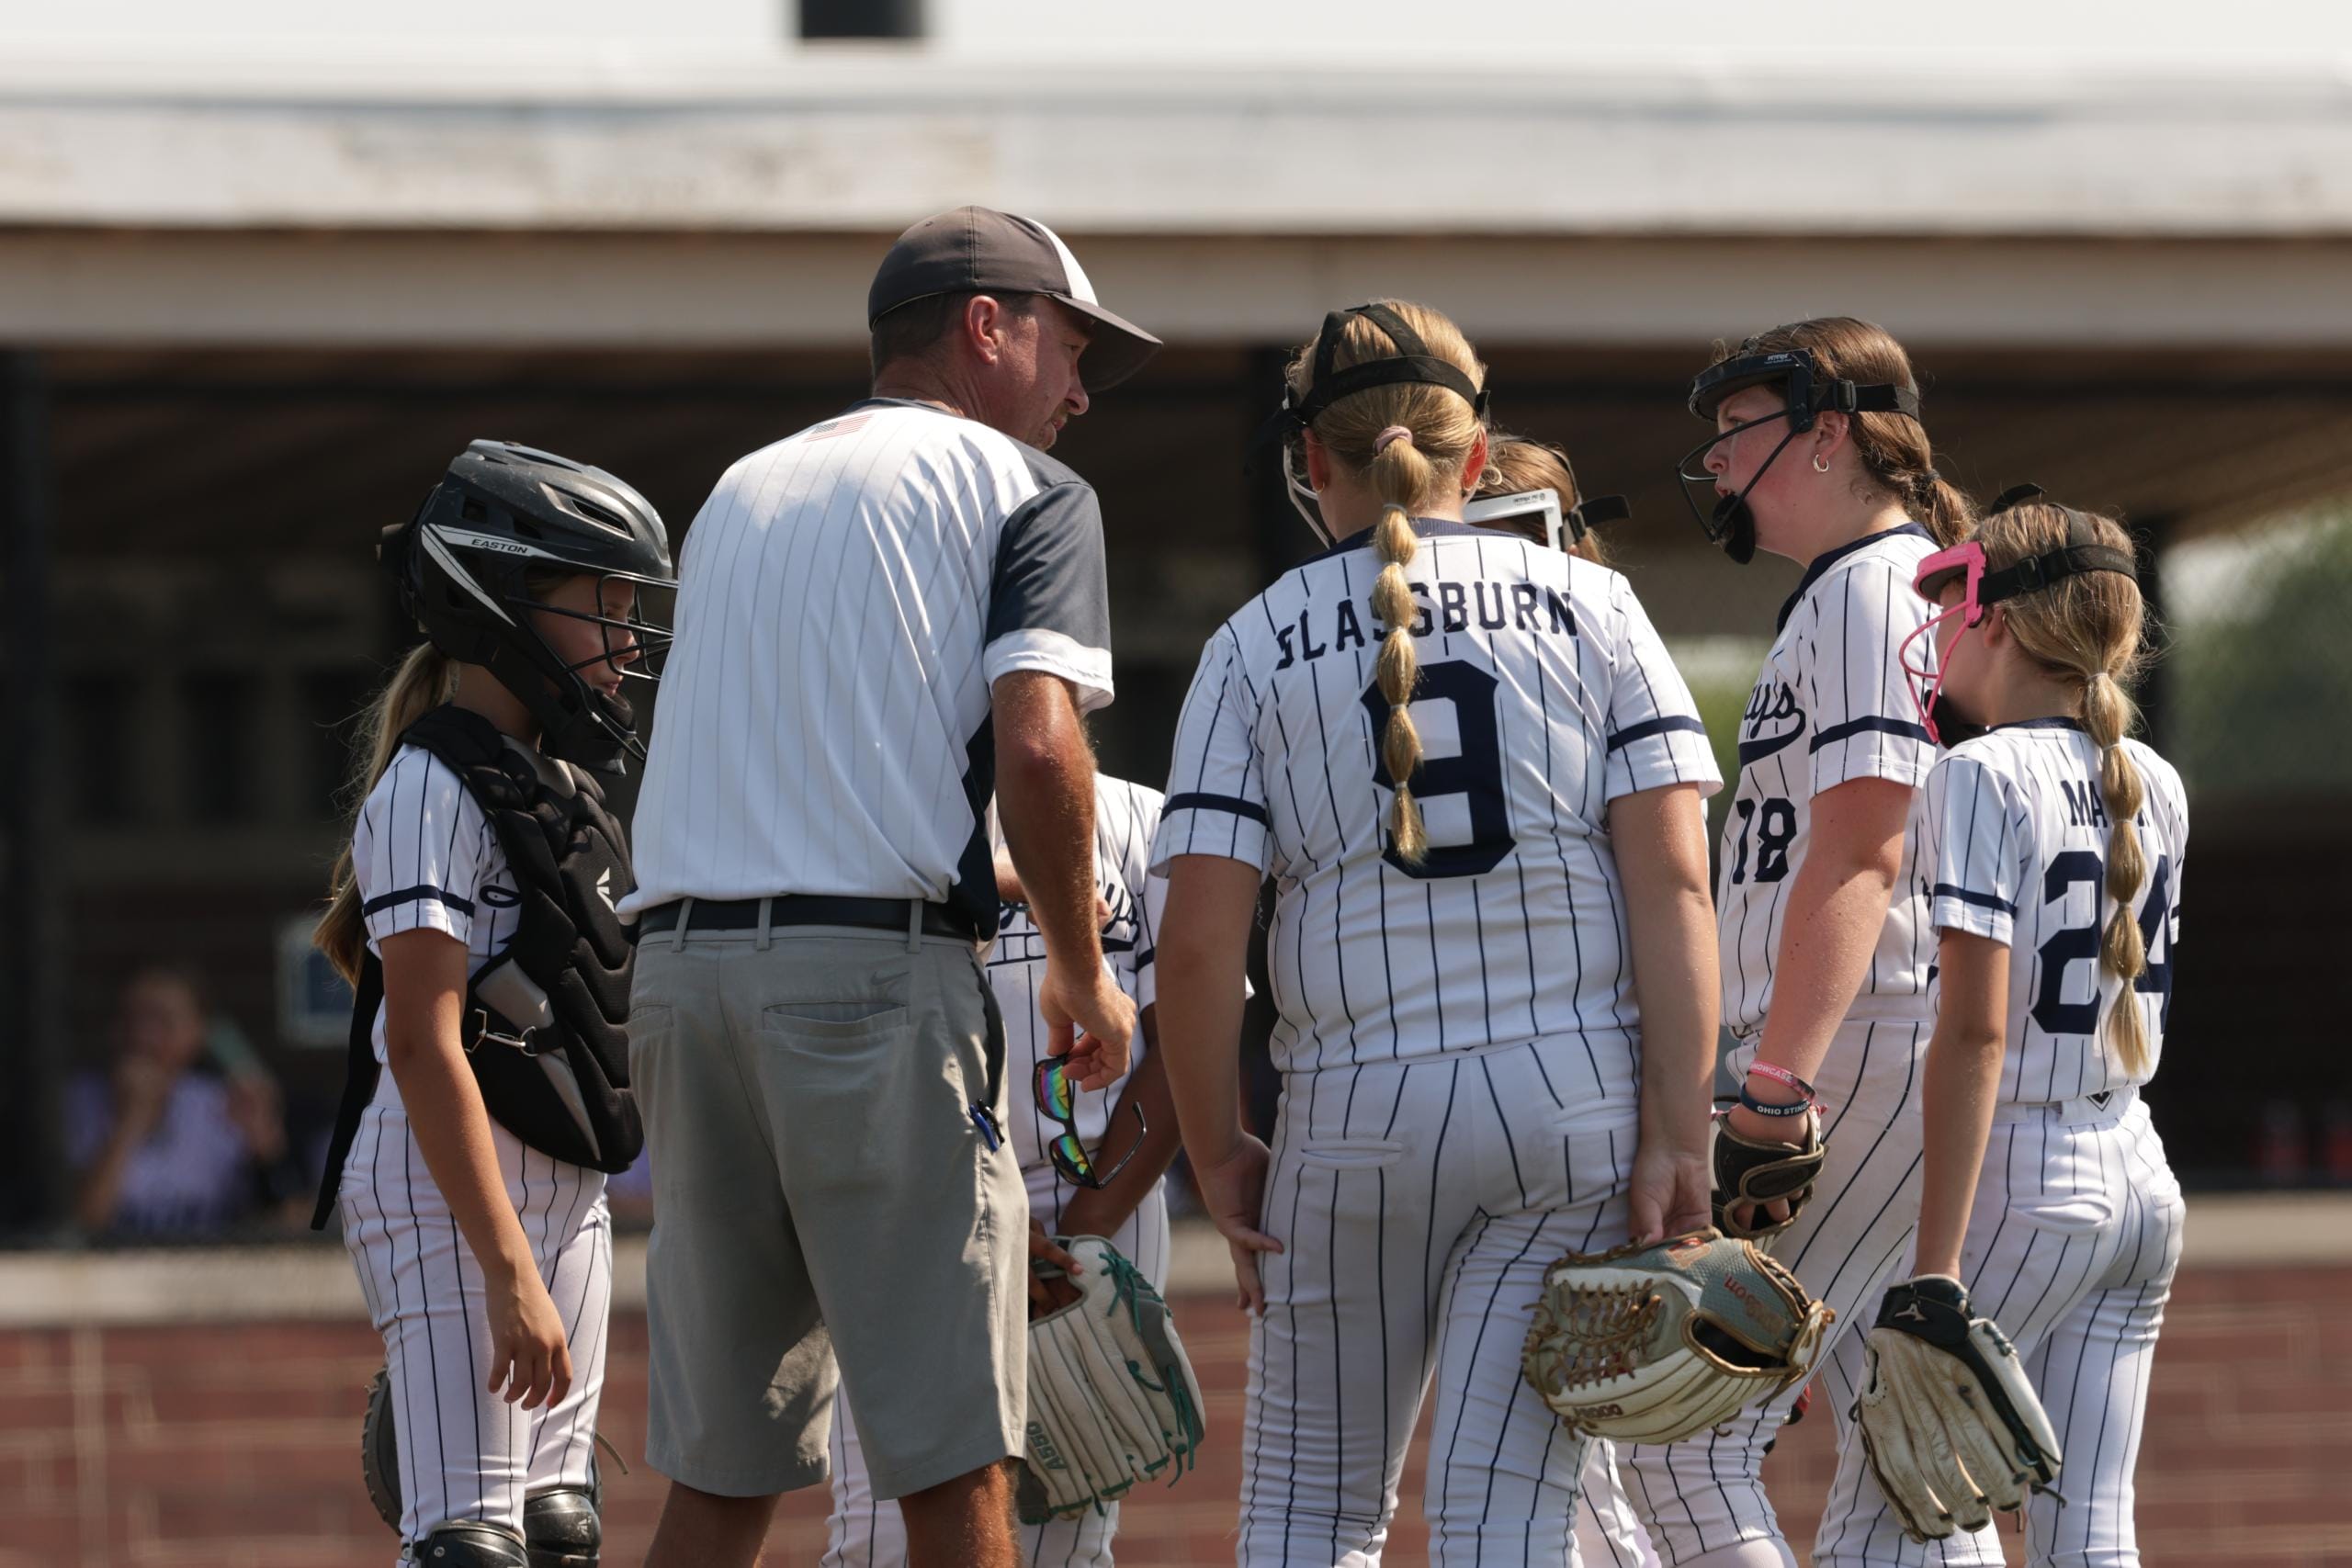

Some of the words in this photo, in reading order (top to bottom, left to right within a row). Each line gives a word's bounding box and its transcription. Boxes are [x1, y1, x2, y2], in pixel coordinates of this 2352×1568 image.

[471, 538, 528, 553] EASTON
[1732, 797, 1798, 883] 18
[2030, 851, 2175, 1035] 24
[1757, 1105, 1781, 1115] OHIO
[1027, 1422, 1068, 1469] A550
